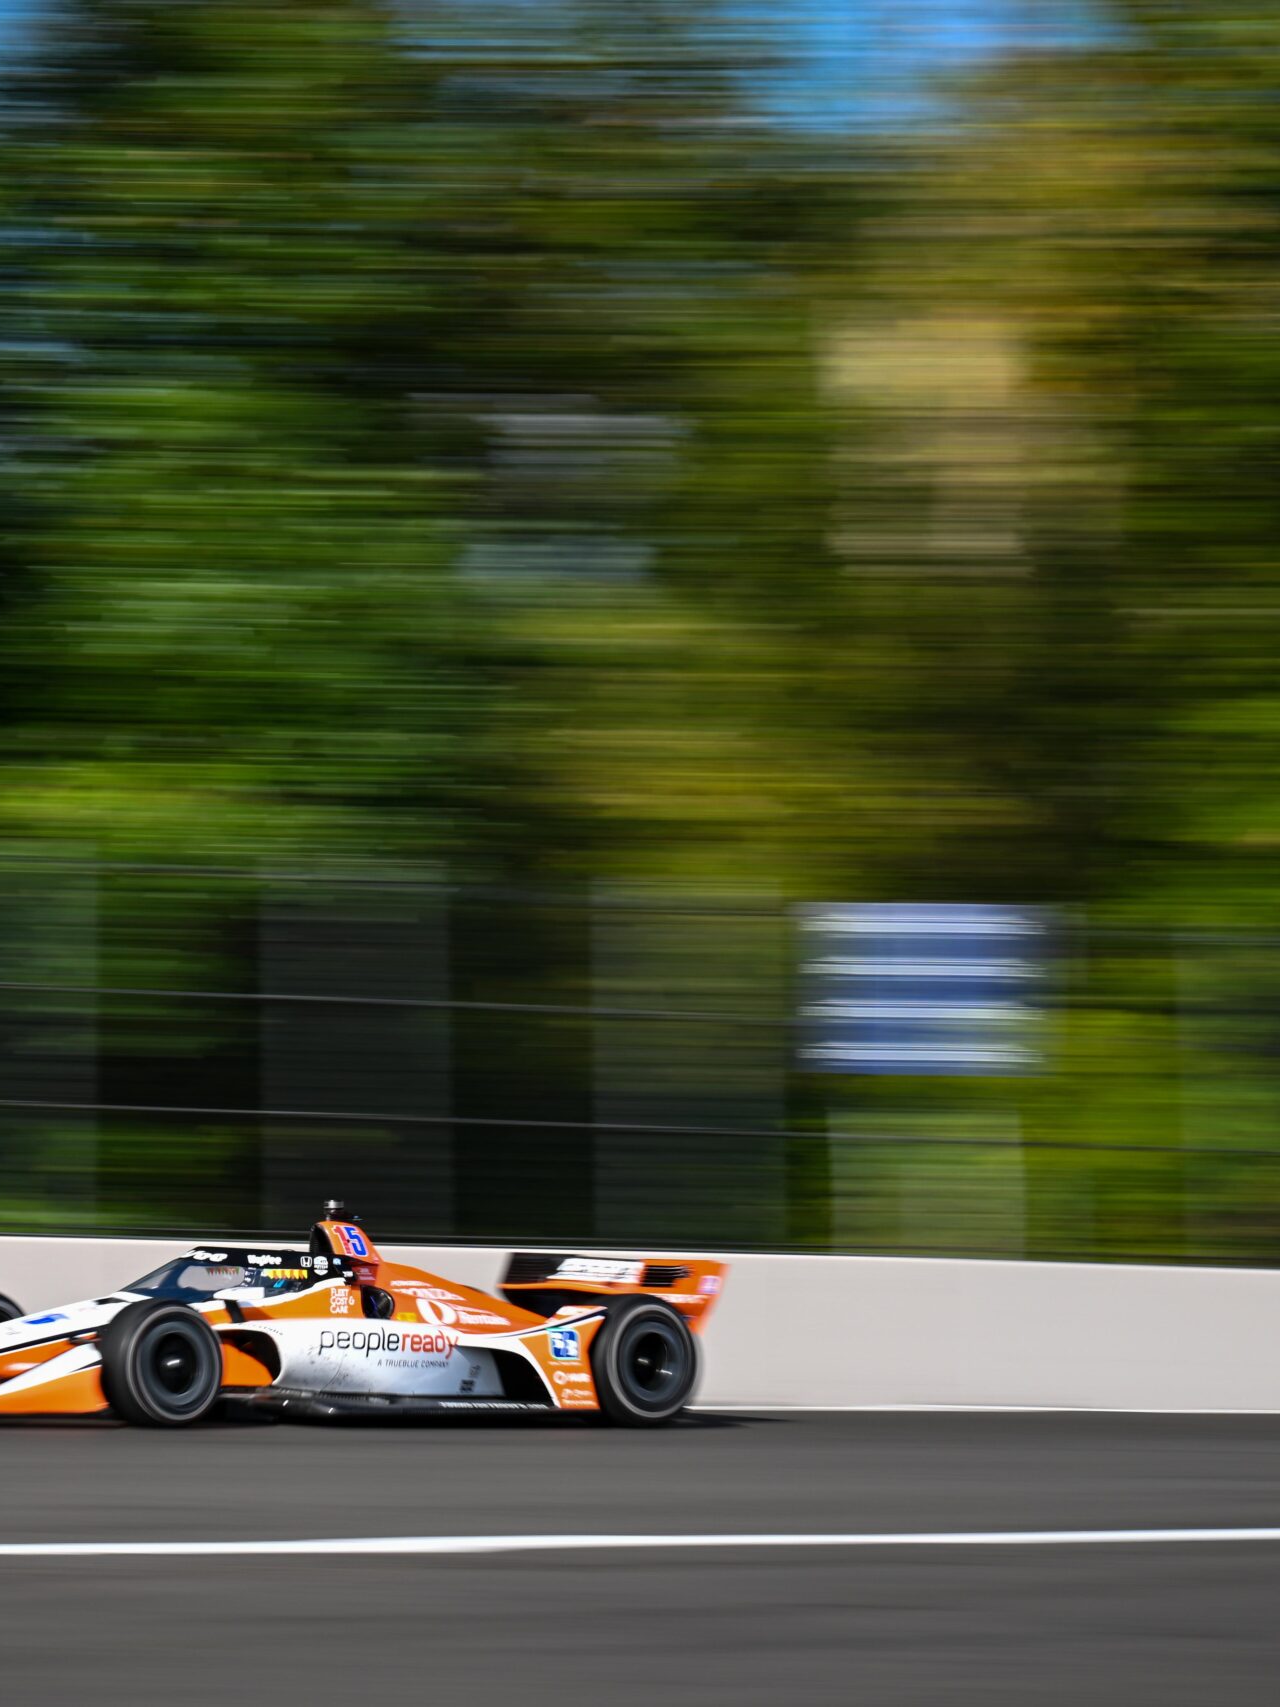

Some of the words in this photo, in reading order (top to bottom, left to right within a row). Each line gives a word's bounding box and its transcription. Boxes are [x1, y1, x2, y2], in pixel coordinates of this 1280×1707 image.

[331, 1225, 368, 1257] 15
[330, 1287, 349, 1298] FLEET
[329, 1296, 348, 1306] COST
[318, 1326, 459, 1360] peopleready
[377, 1359, 382, 1367] A
[385, 1359, 419, 1368] TRUEBLUE
